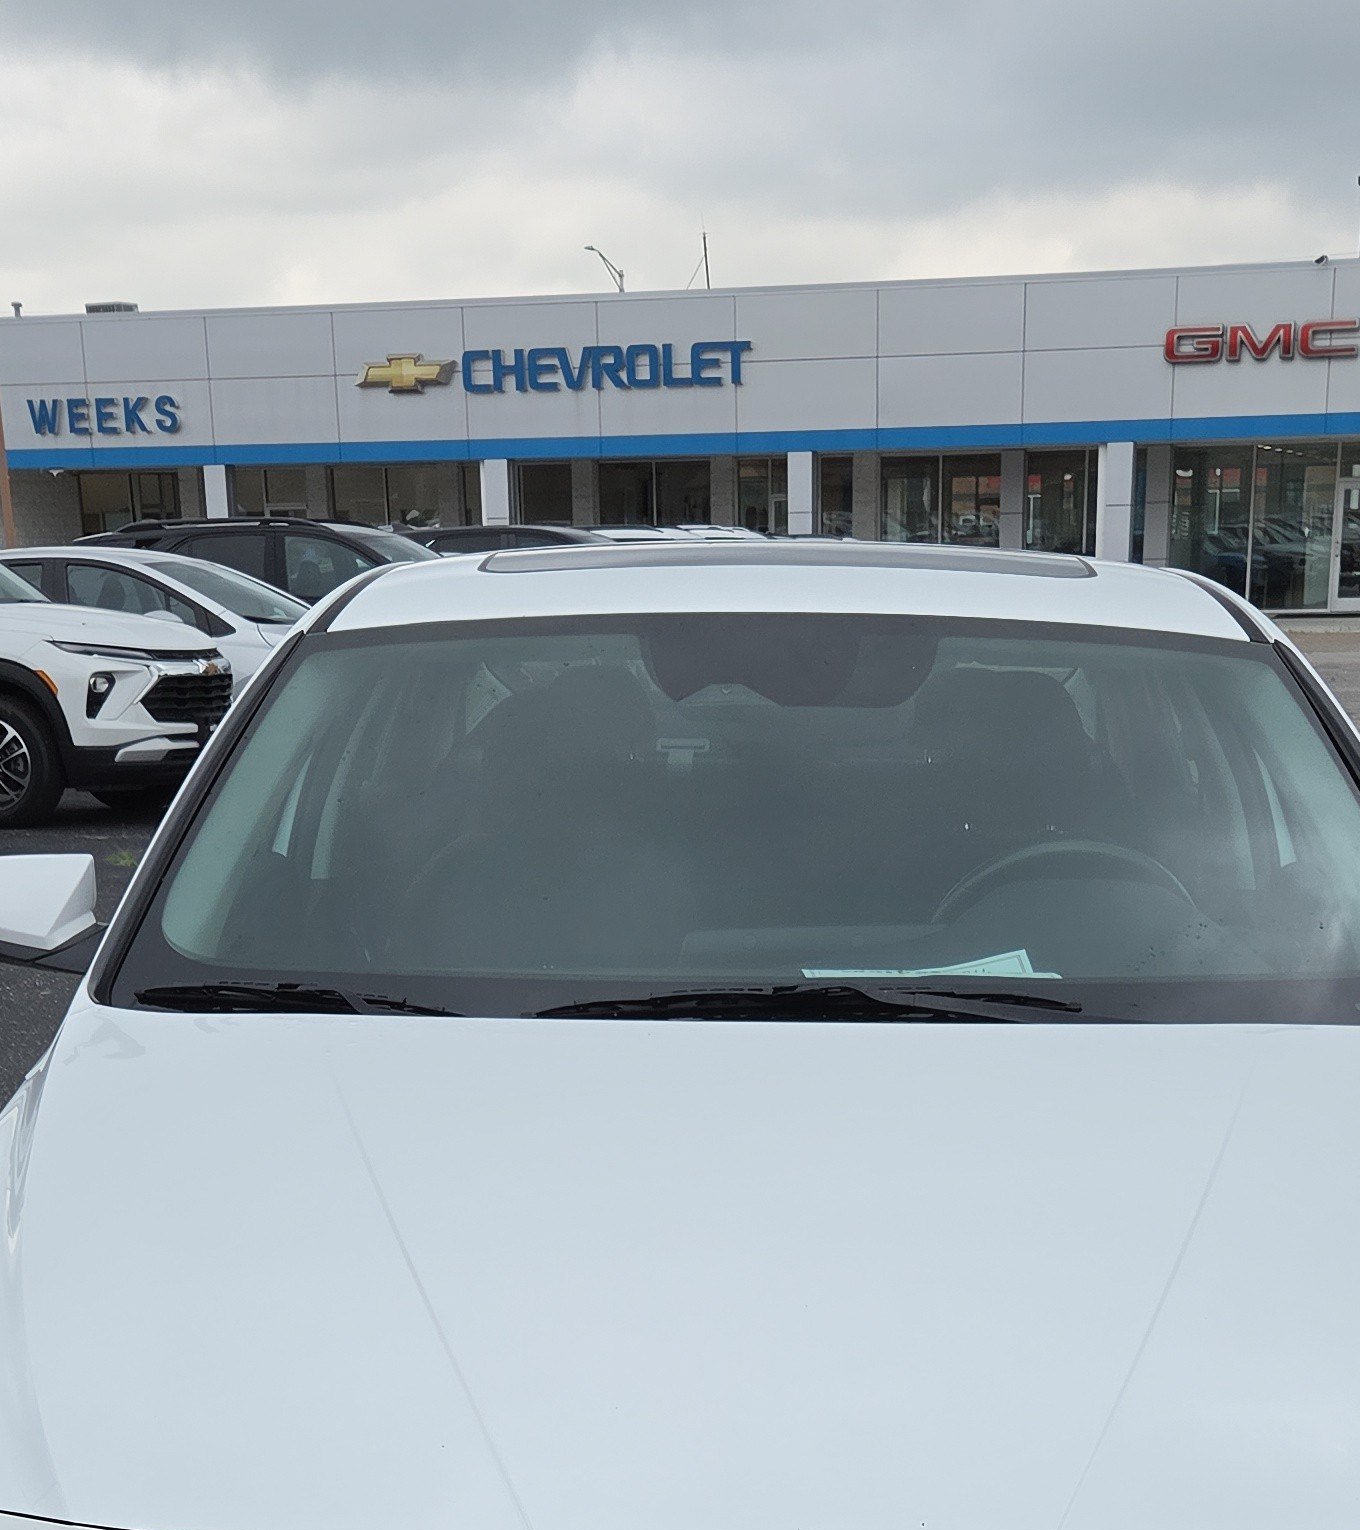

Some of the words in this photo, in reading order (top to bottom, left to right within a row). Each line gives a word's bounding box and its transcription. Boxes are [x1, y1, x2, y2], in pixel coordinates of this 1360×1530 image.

[1163, 316, 1360, 364] GMC
[461, 341, 752, 394] CHEVROLET
[26, 395, 181, 435] WEEKS
